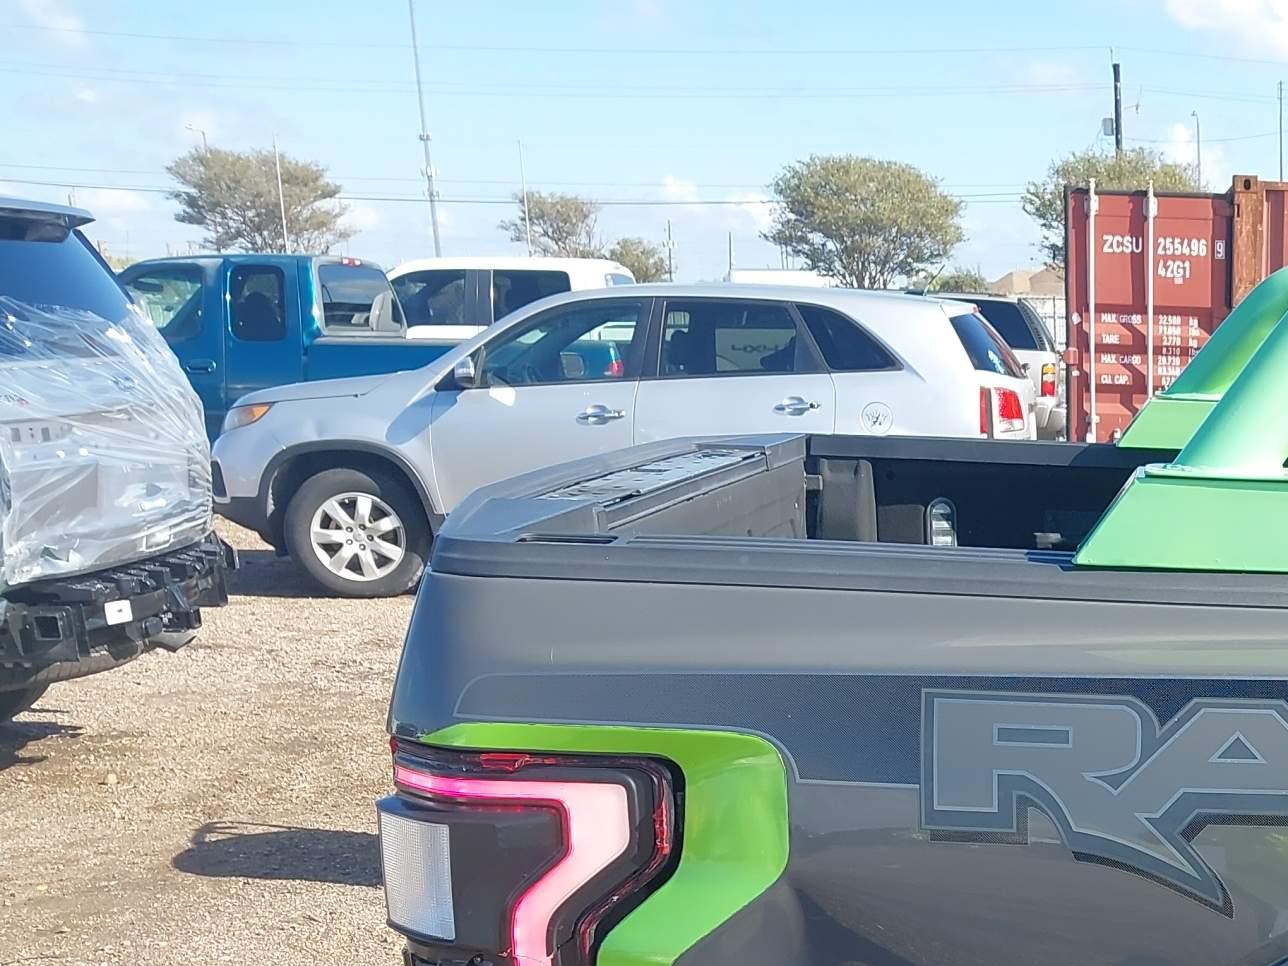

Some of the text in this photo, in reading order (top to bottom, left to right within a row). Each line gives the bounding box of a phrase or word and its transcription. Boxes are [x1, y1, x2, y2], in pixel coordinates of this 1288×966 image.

[1102, 234, 1224, 257] ZCSU 255496 9
[1158, 259, 1190, 279] 42G1
[1119, 314, 1142, 325] GROSS
[1102, 333, 1120, 344] TARE
[1119, 354, 1142, 365] CARGO
